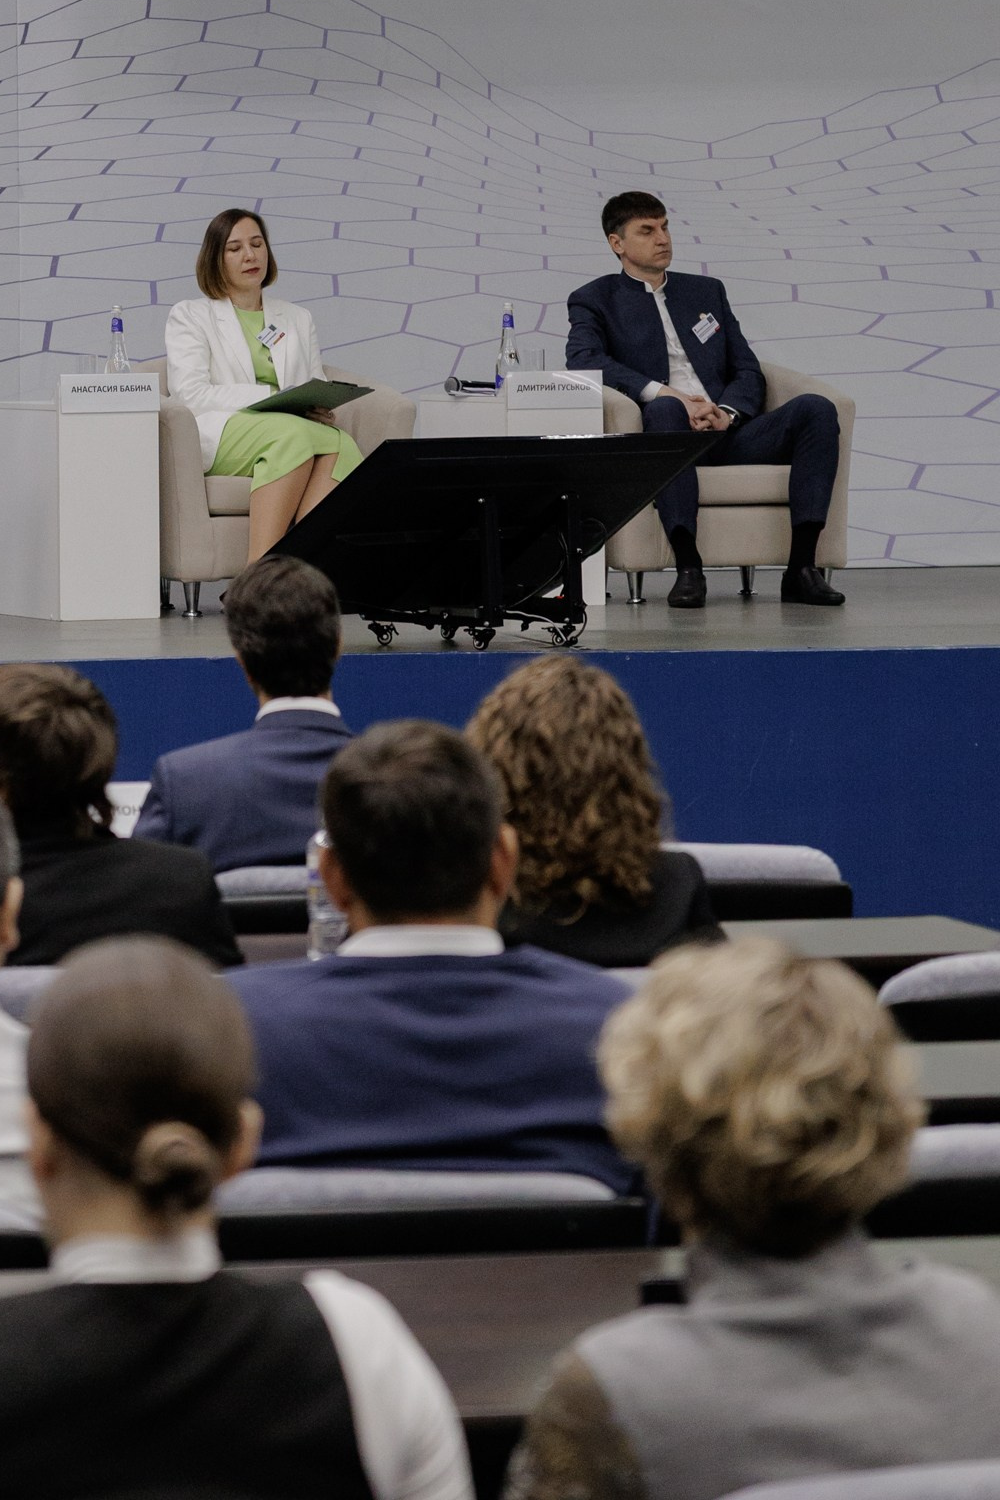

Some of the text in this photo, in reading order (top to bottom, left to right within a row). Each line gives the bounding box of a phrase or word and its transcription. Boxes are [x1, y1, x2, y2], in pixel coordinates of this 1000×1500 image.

[71, 384, 152, 393] АНАСТАСИЯ БАБИНА
[517, 382, 556, 393] ДМИТРИЙ
